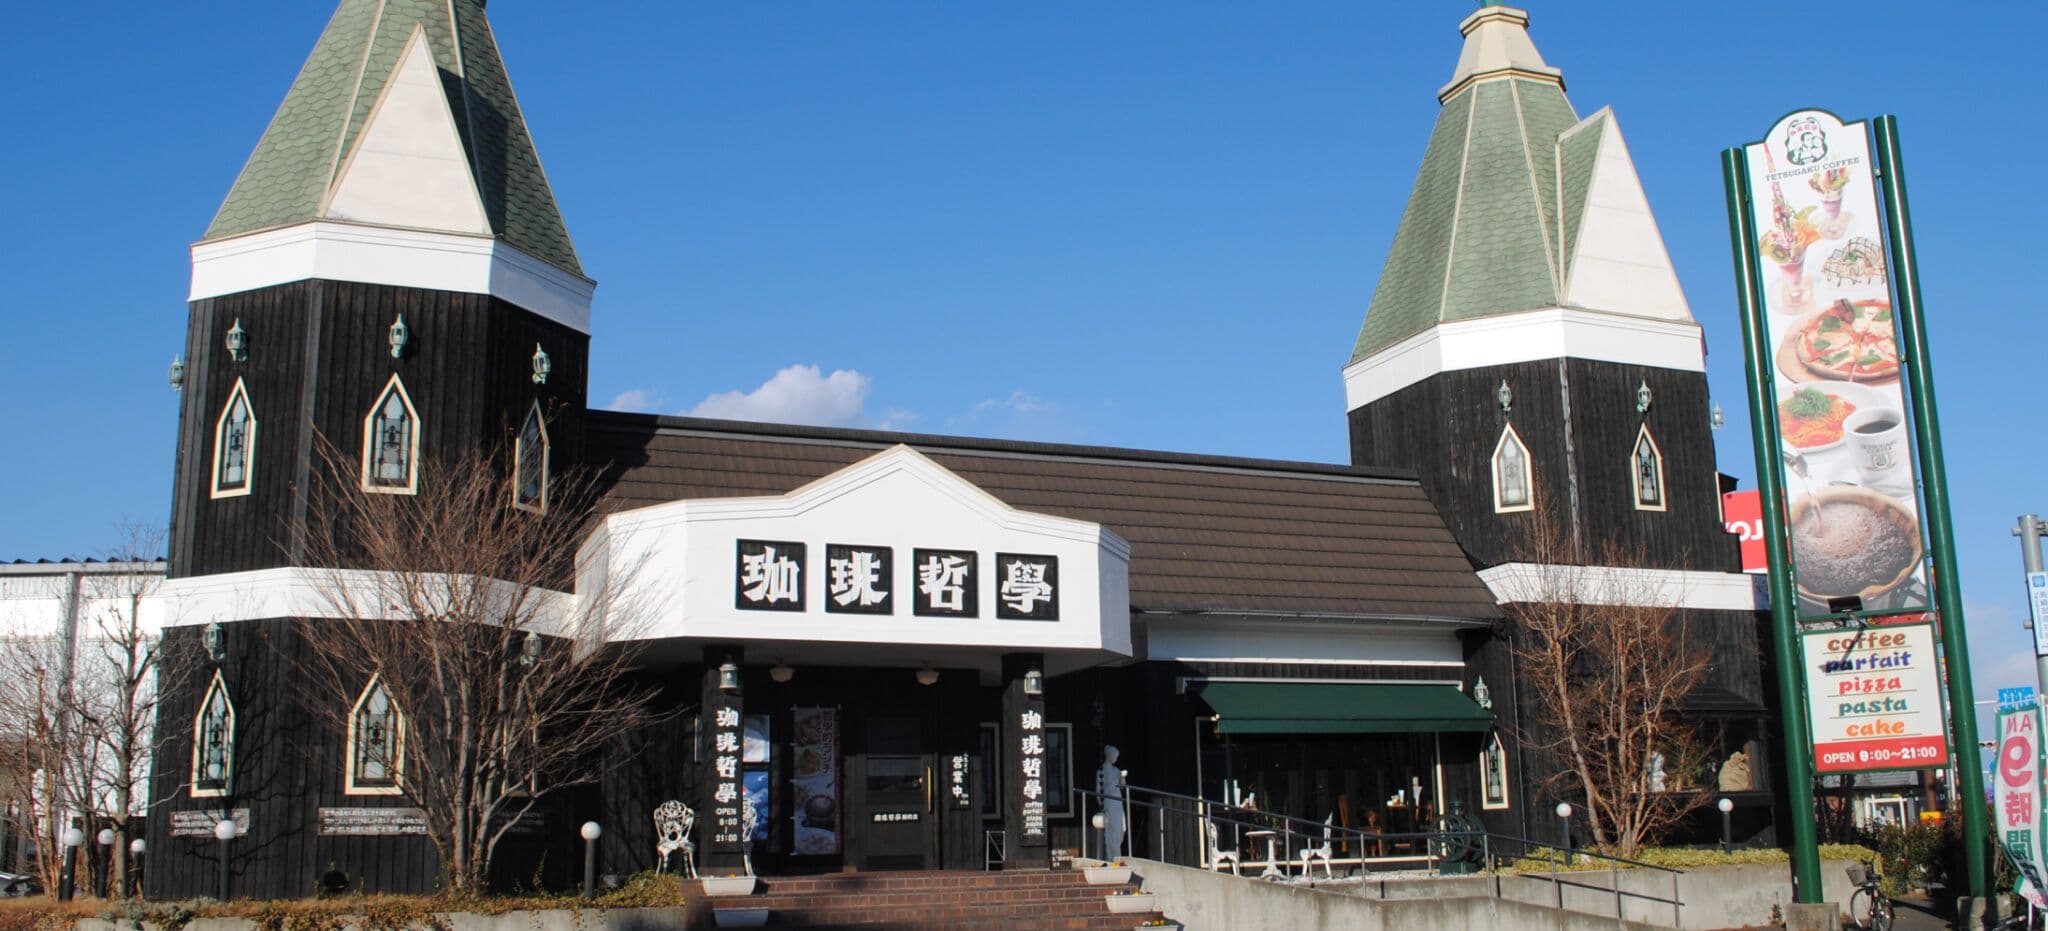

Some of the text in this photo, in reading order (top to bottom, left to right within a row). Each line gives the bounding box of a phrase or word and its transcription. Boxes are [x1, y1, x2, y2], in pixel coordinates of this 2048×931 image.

[1765, 157, 1860, 182] TETSUGAKU COFFEE
[742, 546, 1053, 613] 珈琲哲學
[1827, 632, 1906, 651] coffee
[1825, 651, 1911, 673] parfait
[1839, 675, 1901, 695] pizza
[1839, 697, 1907, 717] pasta
[1846, 719, 1905, 736] cake
[1823, 752, 1855, 764] OPEN
[715, 808, 737, 816] OPEN
[715, 833, 738, 842] 21:00
